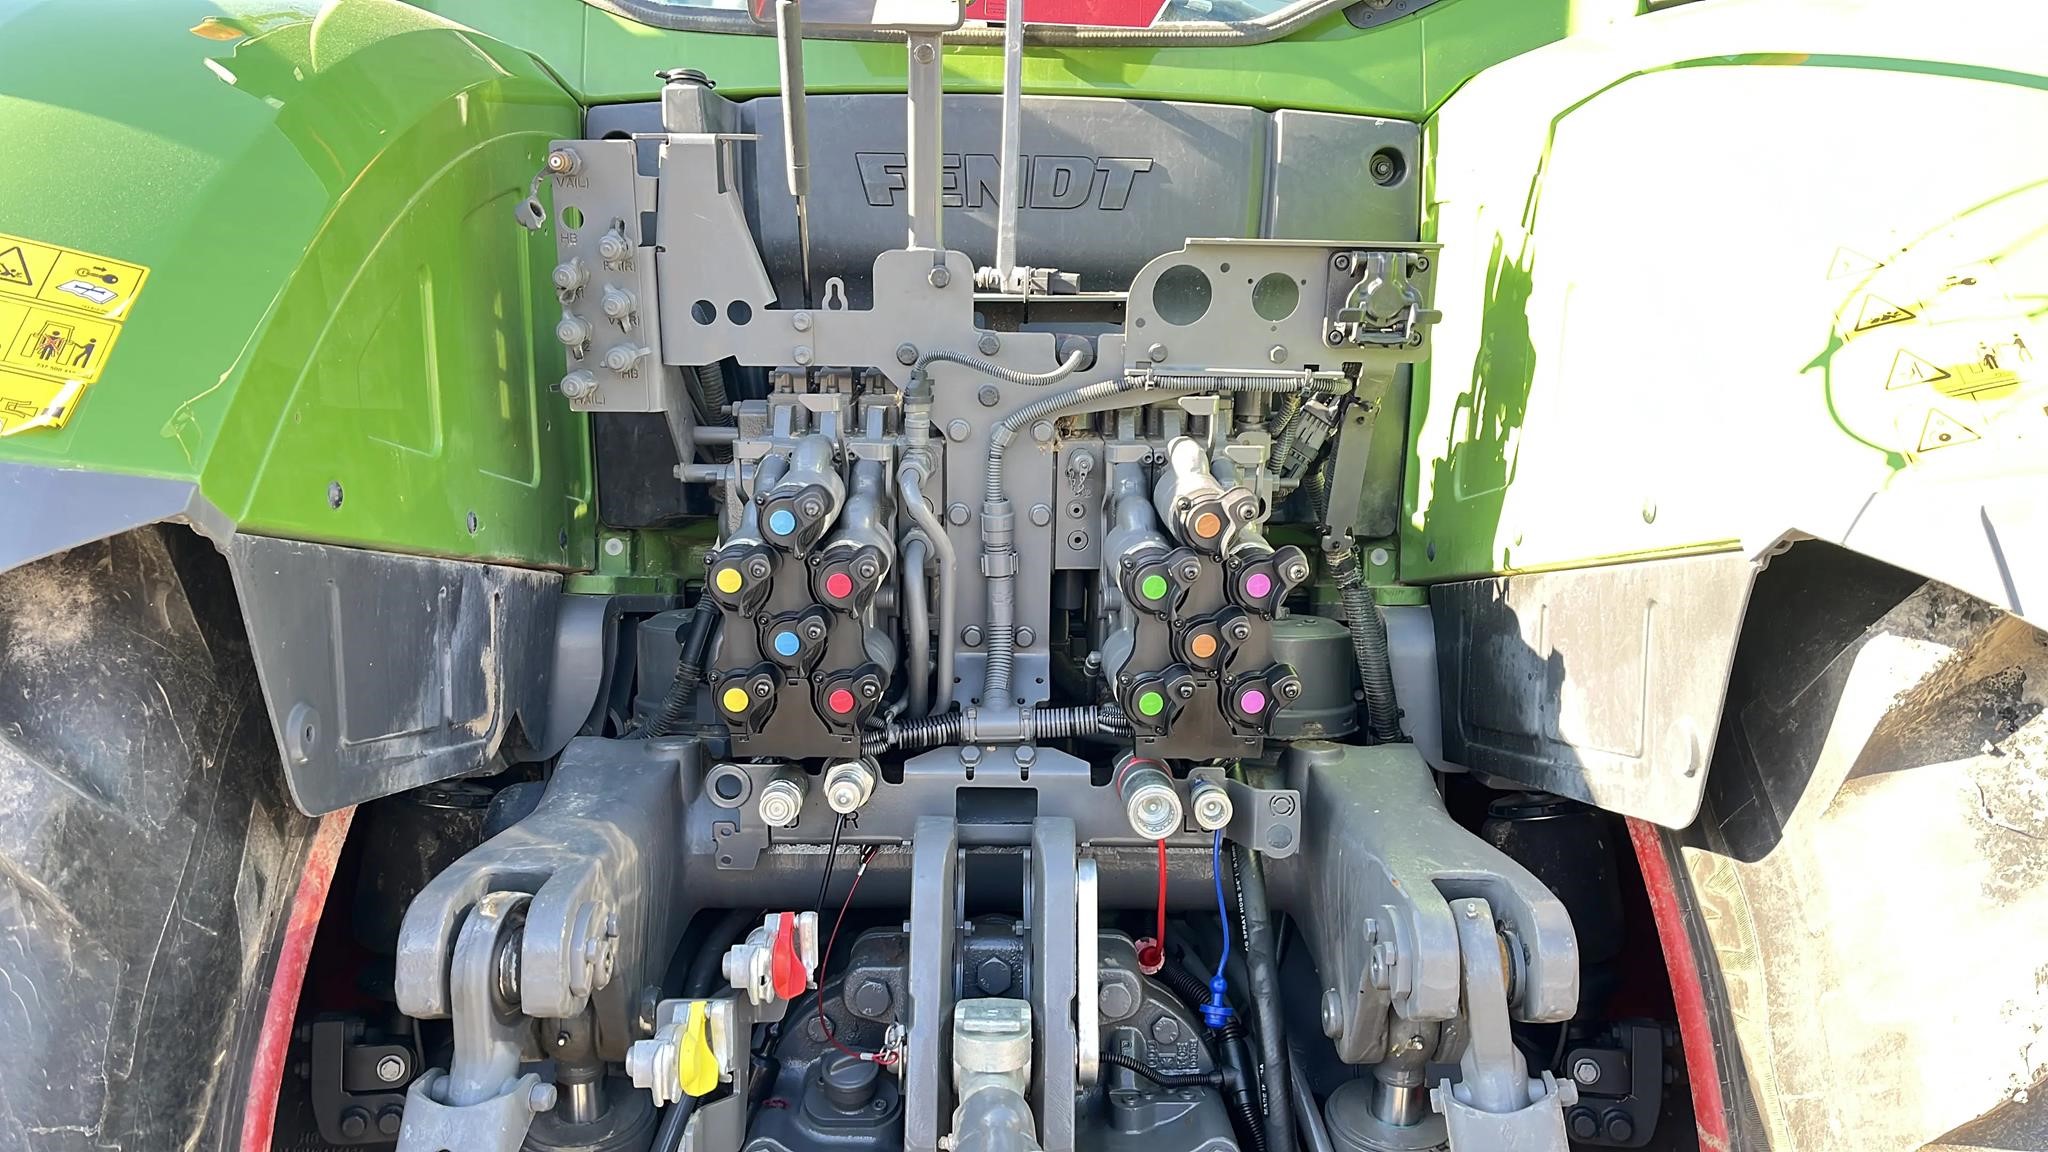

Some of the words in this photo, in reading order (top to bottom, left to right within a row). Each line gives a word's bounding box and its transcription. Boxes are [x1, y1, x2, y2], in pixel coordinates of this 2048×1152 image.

[556, 176, 589, 190] VA(L)
[1237, 892, 1245, 914] HOSE
[1240, 914, 1248, 940] SPRAY
